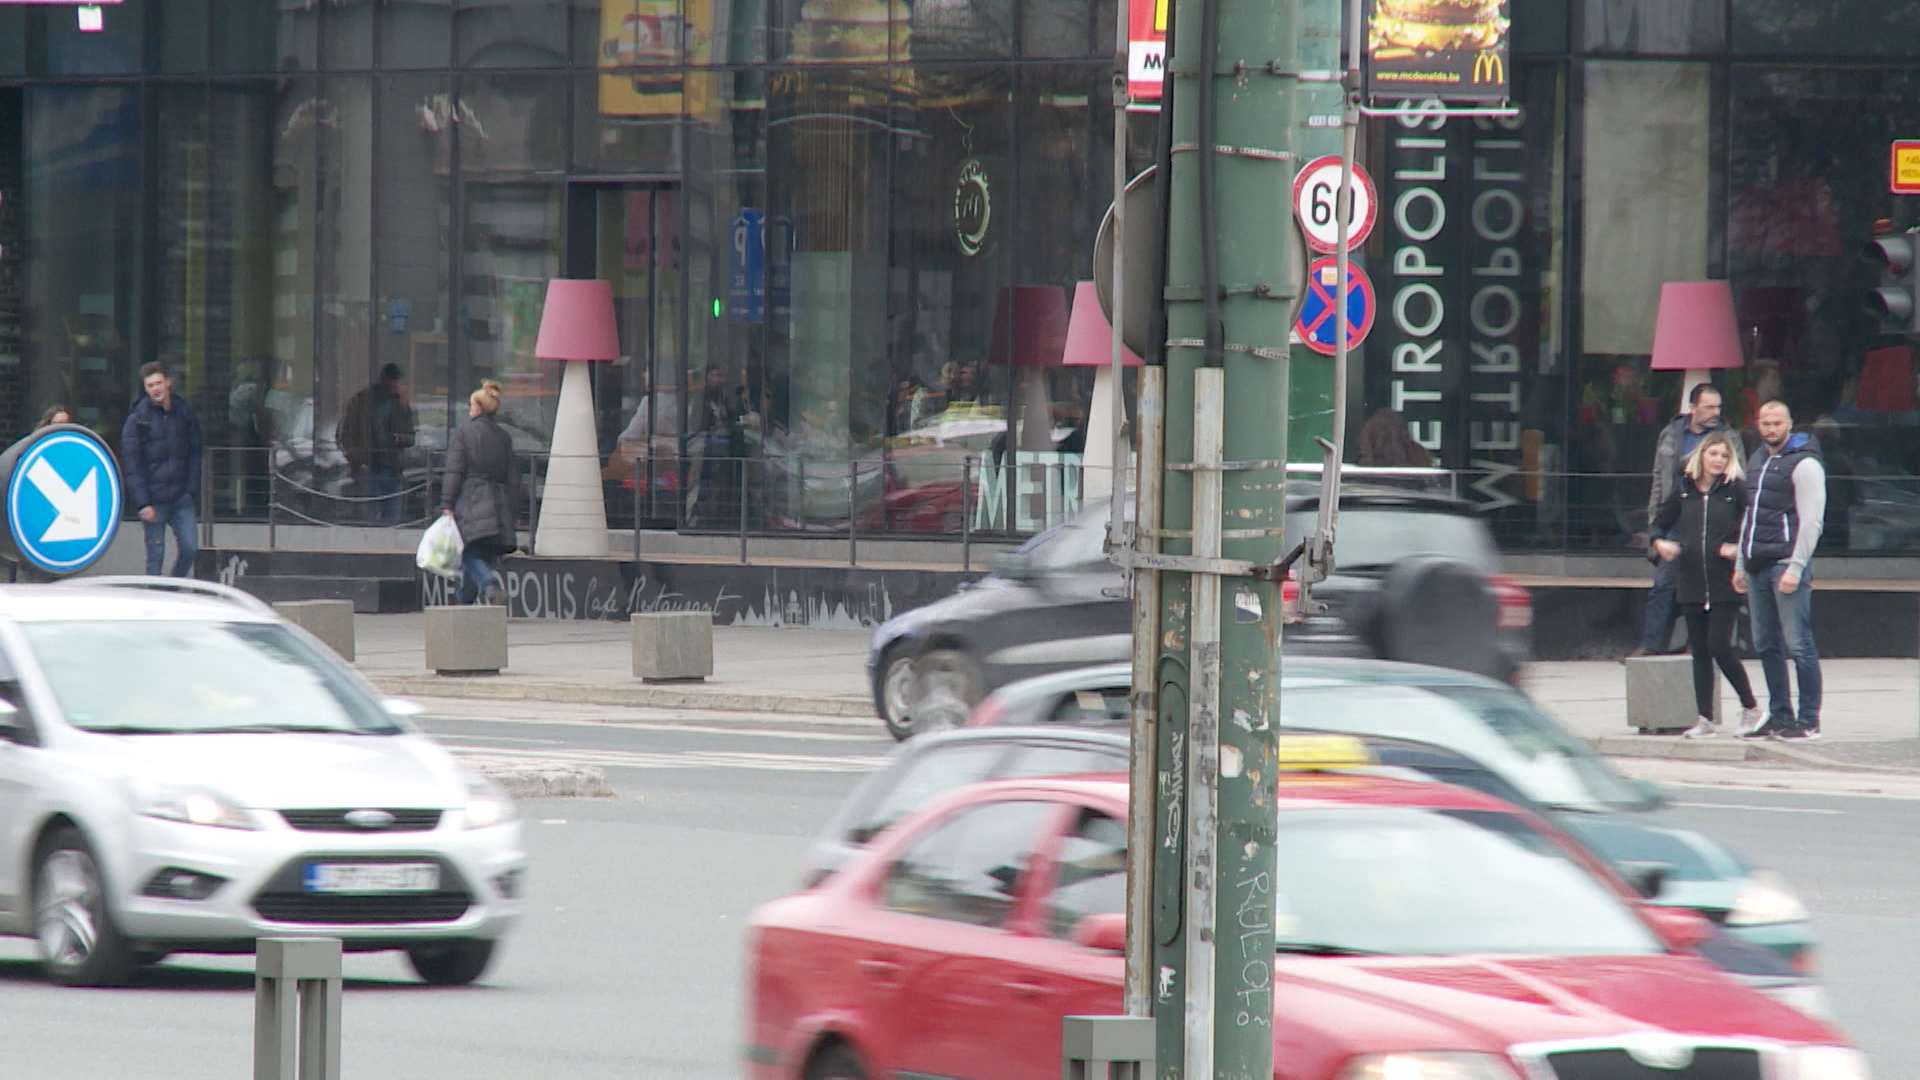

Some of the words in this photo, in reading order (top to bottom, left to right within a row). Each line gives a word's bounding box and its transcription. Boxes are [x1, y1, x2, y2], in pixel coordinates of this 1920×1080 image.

[1143, 53, 1166, 69] M
[1391, 98, 1447, 467] ETROPOLIS
[975, 451, 1083, 531] METR
[422, 570, 576, 619] MEPOLIS
[626, 575, 741, 617] Restaurant
